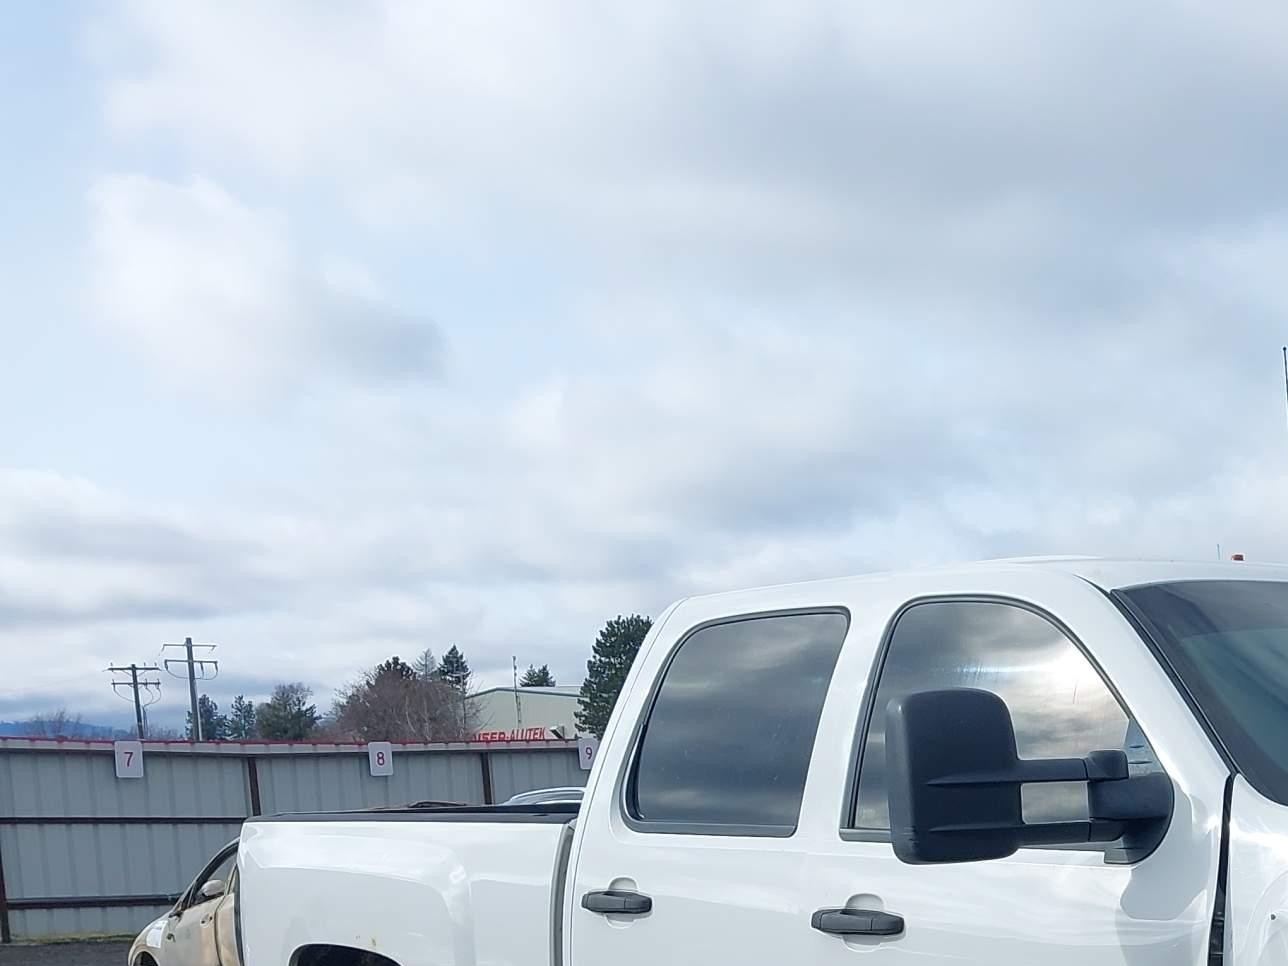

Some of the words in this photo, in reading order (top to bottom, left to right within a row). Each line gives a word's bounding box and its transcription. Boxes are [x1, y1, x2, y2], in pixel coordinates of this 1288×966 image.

[123, 751, 134, 767] 7
[376, 751, 385, 766] 8
[585, 746, 593, 760] 9
